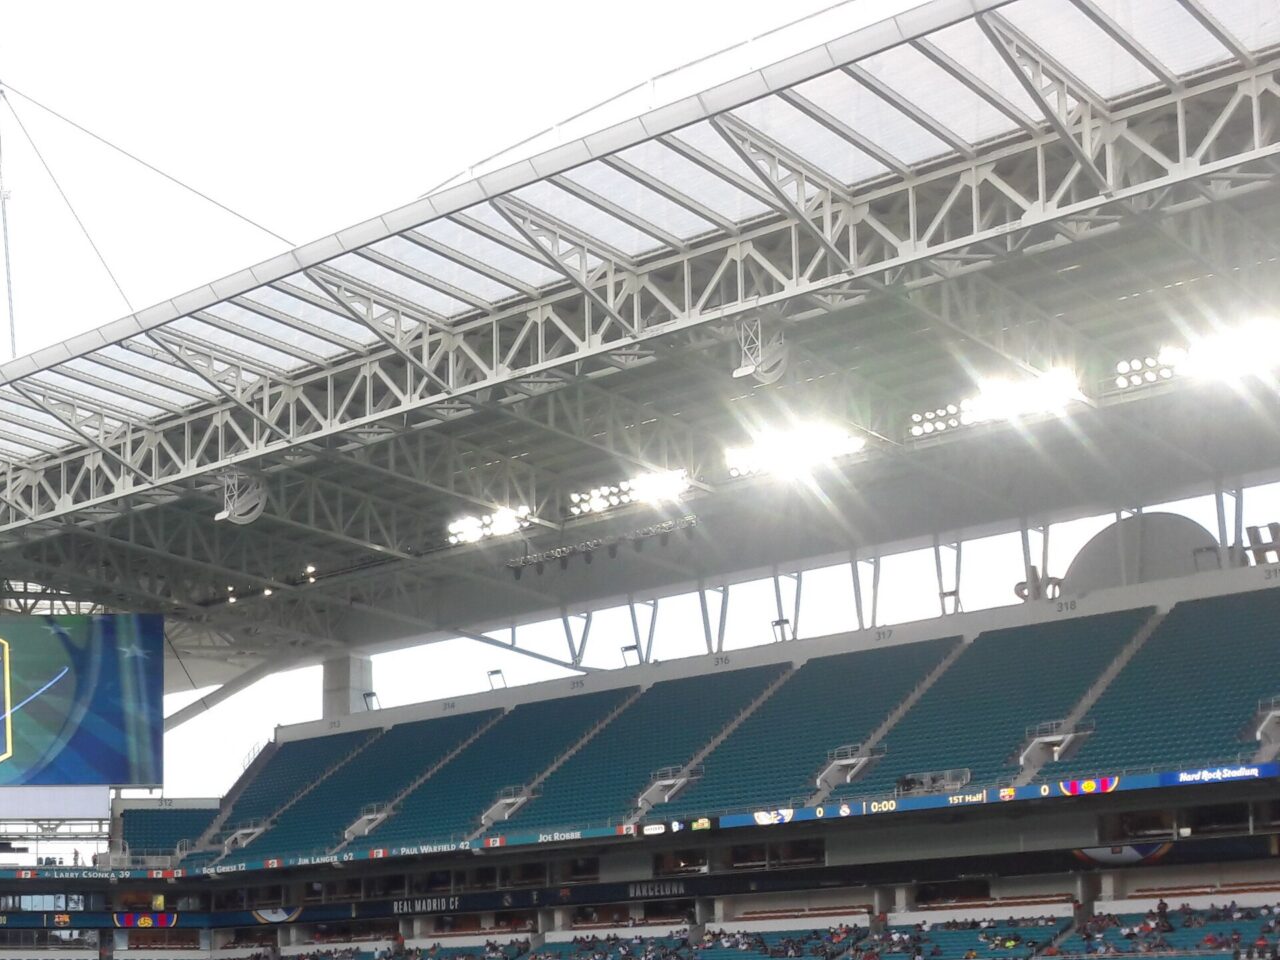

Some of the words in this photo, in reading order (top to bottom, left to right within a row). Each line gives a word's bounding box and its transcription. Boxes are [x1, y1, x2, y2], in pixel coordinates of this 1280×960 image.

[1057, 601, 1076, 612] 318
[1180, 771, 1202, 782] Hard
[1202, 769, 1221, 780] Rock
[1222, 766, 1258, 778] Stadium
[1041, 785, 1049, 796] 0
[871, 800, 896, 812] 0:00
[816, 807, 824, 818] 0
[538, 833, 553, 842] JOE
[553, 831, 581, 841] ROBBIE
[401, 846, 418, 855] PAUL
[459, 841, 470, 850] 42
[54, 871, 79, 879] LARRY
[82, 871, 116, 879] CSONKA
[393, 900, 411, 913] REAL
[414, 898, 446, 912] MADRID
[449, 896, 459, 909] CF
